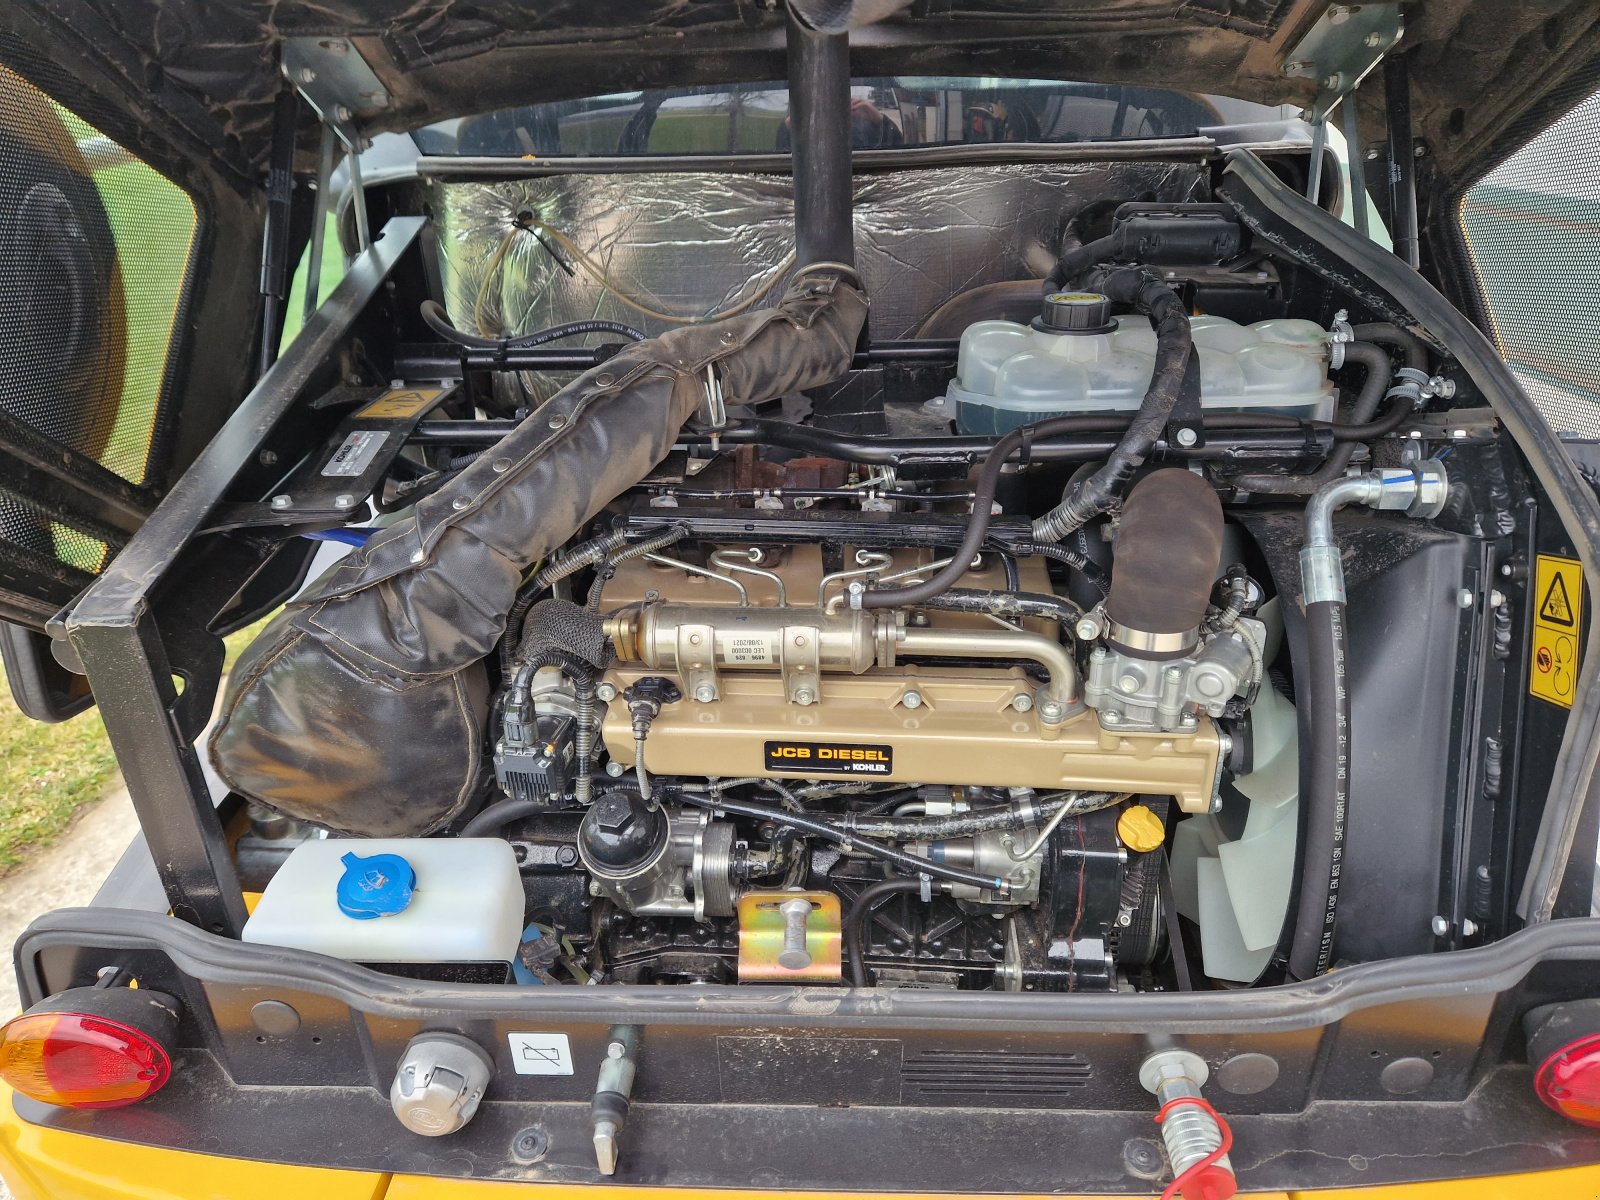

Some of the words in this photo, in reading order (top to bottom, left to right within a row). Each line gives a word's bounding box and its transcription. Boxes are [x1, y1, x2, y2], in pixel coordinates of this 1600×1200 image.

[1331, 605, 1341, 623] MPa
[1333, 625, 1343, 641] 10.5
[1336, 648, 1345, 662] bar
[1336, 664, 1345, 677] 105
[1337, 686, 1347, 700] WP
[771, 747, 811, 759] JCB
[818, 748, 889, 761] DIESEL
[1338, 755, 1347, 765] 19
[1337, 766, 1346, 779] DN
[1336, 791, 1346, 823] 100R1AT
[1334, 825, 1344, 841] SAE
[1333, 847, 1342, 862] 1SN
[1331, 864, 1340, 877] 853
[1330, 878, 1339, 890] EN
[1325, 911, 1335, 924] ISO
